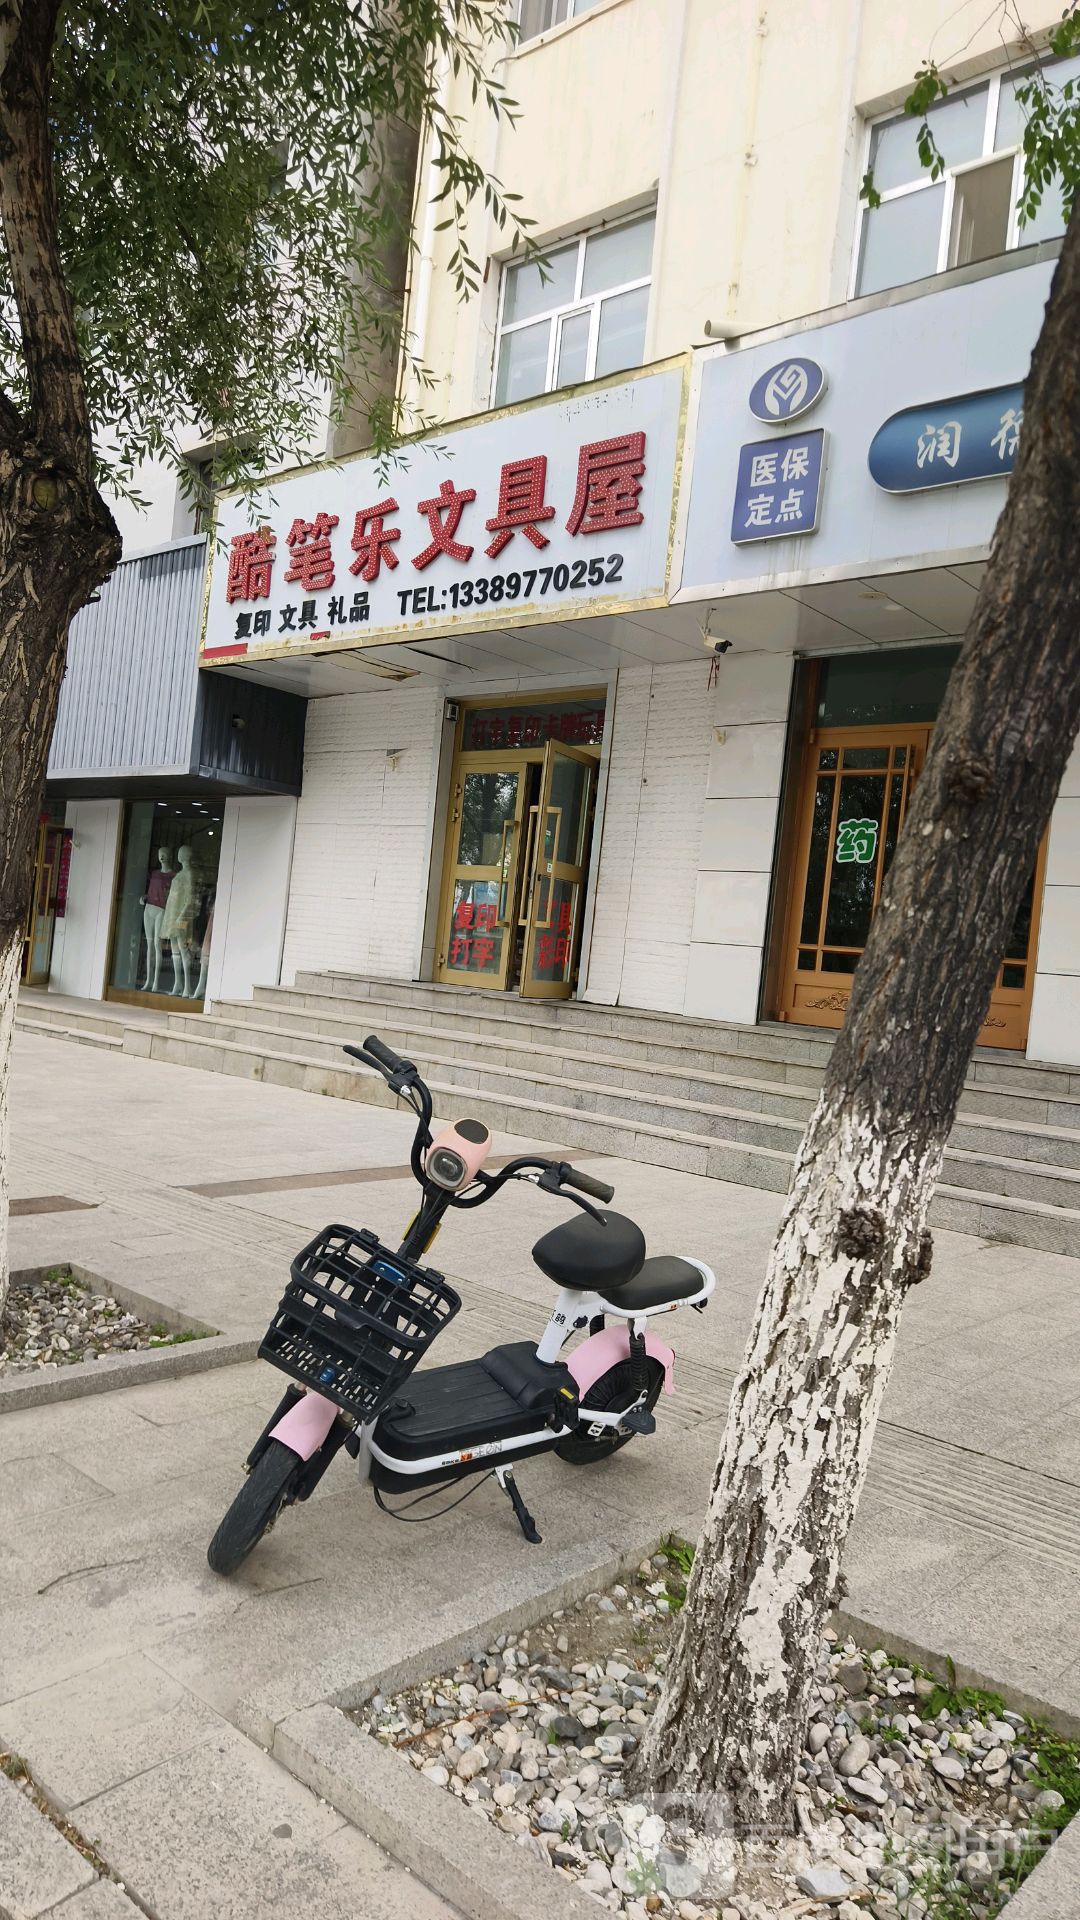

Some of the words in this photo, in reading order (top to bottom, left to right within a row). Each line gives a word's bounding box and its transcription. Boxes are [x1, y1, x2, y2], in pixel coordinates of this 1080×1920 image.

[750, 446, 810, 488] 医保
[226, 430, 647, 604] 酷笔乐文具屋
[744, 488, 805, 529] 定点
[397, 553, 624, 617] TEL:13389770252
[235, 609, 271, 640] 复印
[279, 599, 318, 634] 文具
[327, 590, 370, 626] 礼品
[836, 817, 879, 864] 药
[454, 899, 498, 933] 复印
[450, 937, 494, 968] 打字
